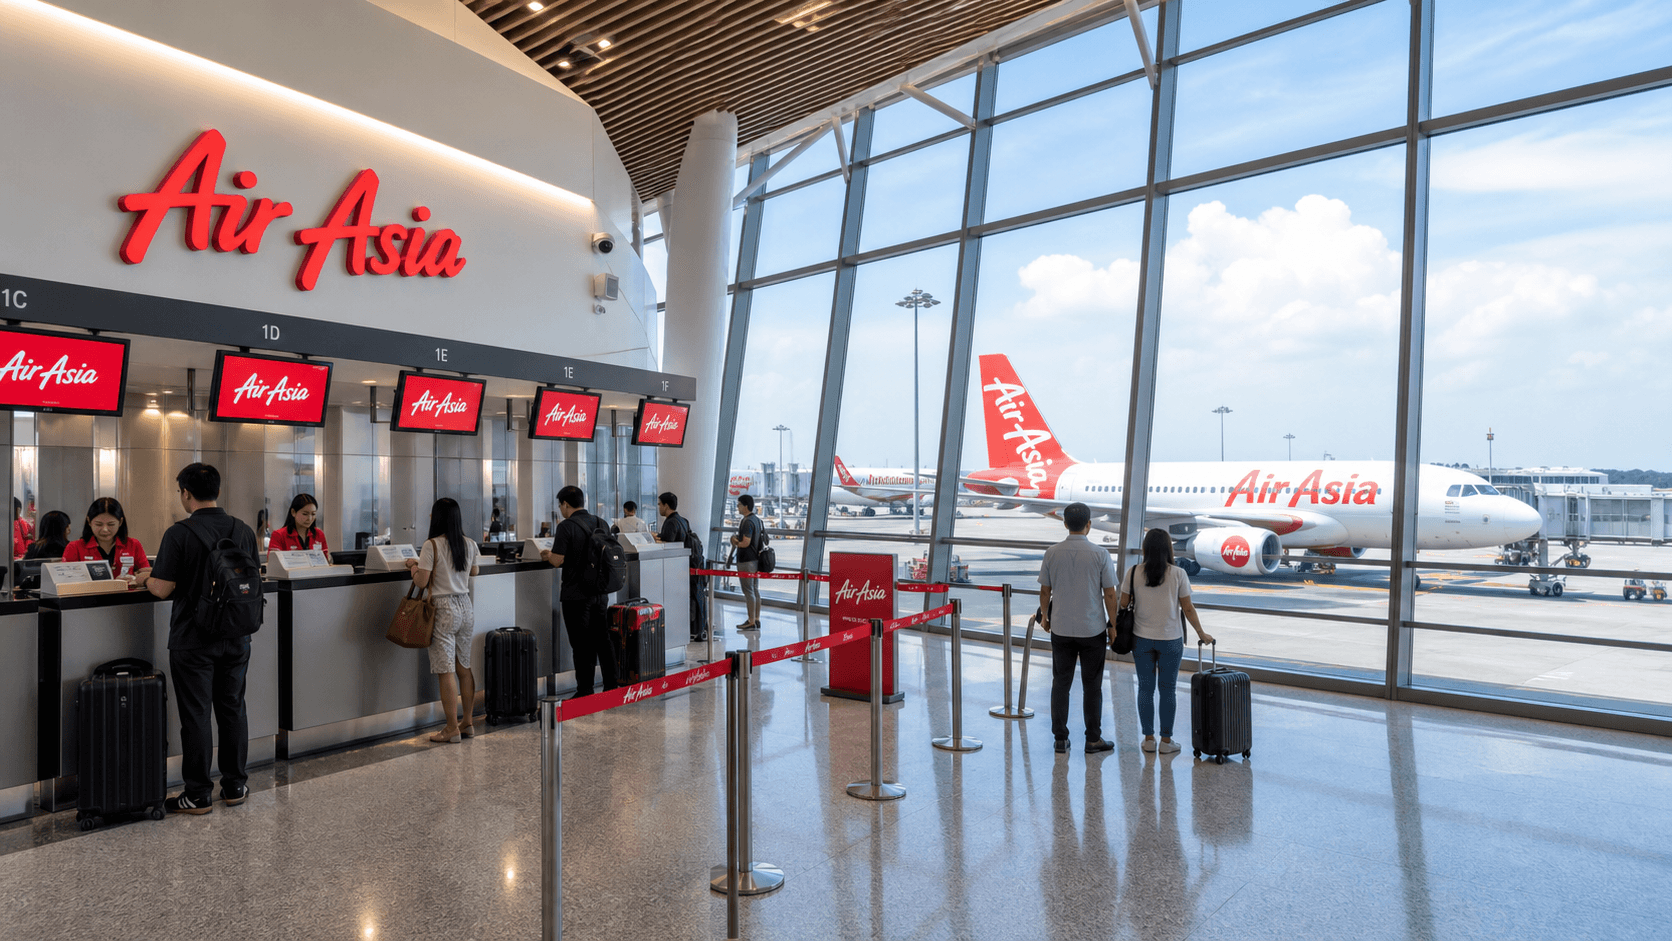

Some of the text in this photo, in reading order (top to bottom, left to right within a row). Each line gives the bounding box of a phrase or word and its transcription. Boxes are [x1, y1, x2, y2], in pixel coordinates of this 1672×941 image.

[118, 128, 467, 292] Air Asia
[1, 288, 28, 309] 1C
[261, 324, 280, 341] 1D
[435, 347, 448, 362] 1E
[563, 366, 574, 379] 1E
[661, 380, 670, 392] 1F
